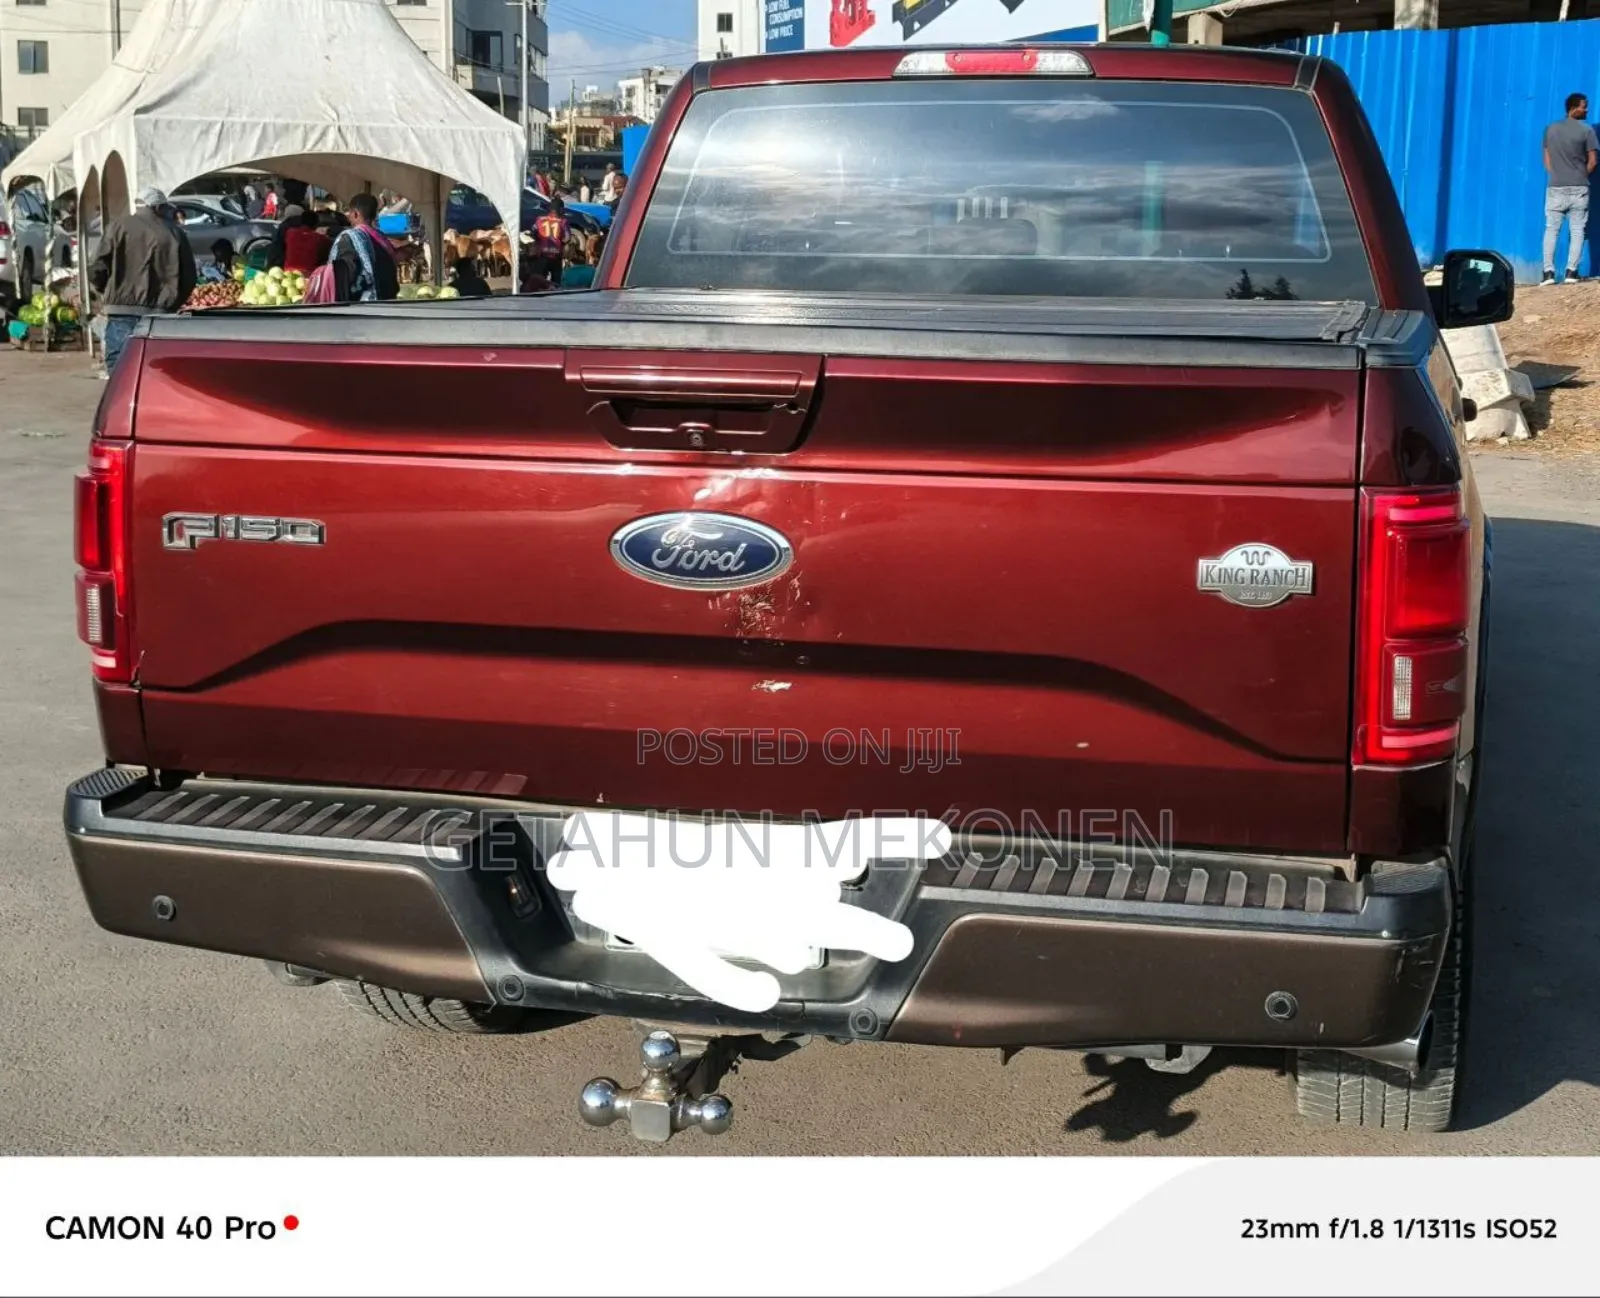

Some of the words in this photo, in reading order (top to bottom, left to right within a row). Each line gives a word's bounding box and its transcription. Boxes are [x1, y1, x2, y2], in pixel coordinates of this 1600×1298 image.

[768, 28, 779, 40] LOW
[543, 220, 560, 239] 11
[651, 524, 748, 572] Ford
[1204, 564, 1246, 585] KING
[1249, 566, 1307, 587] RANCH
